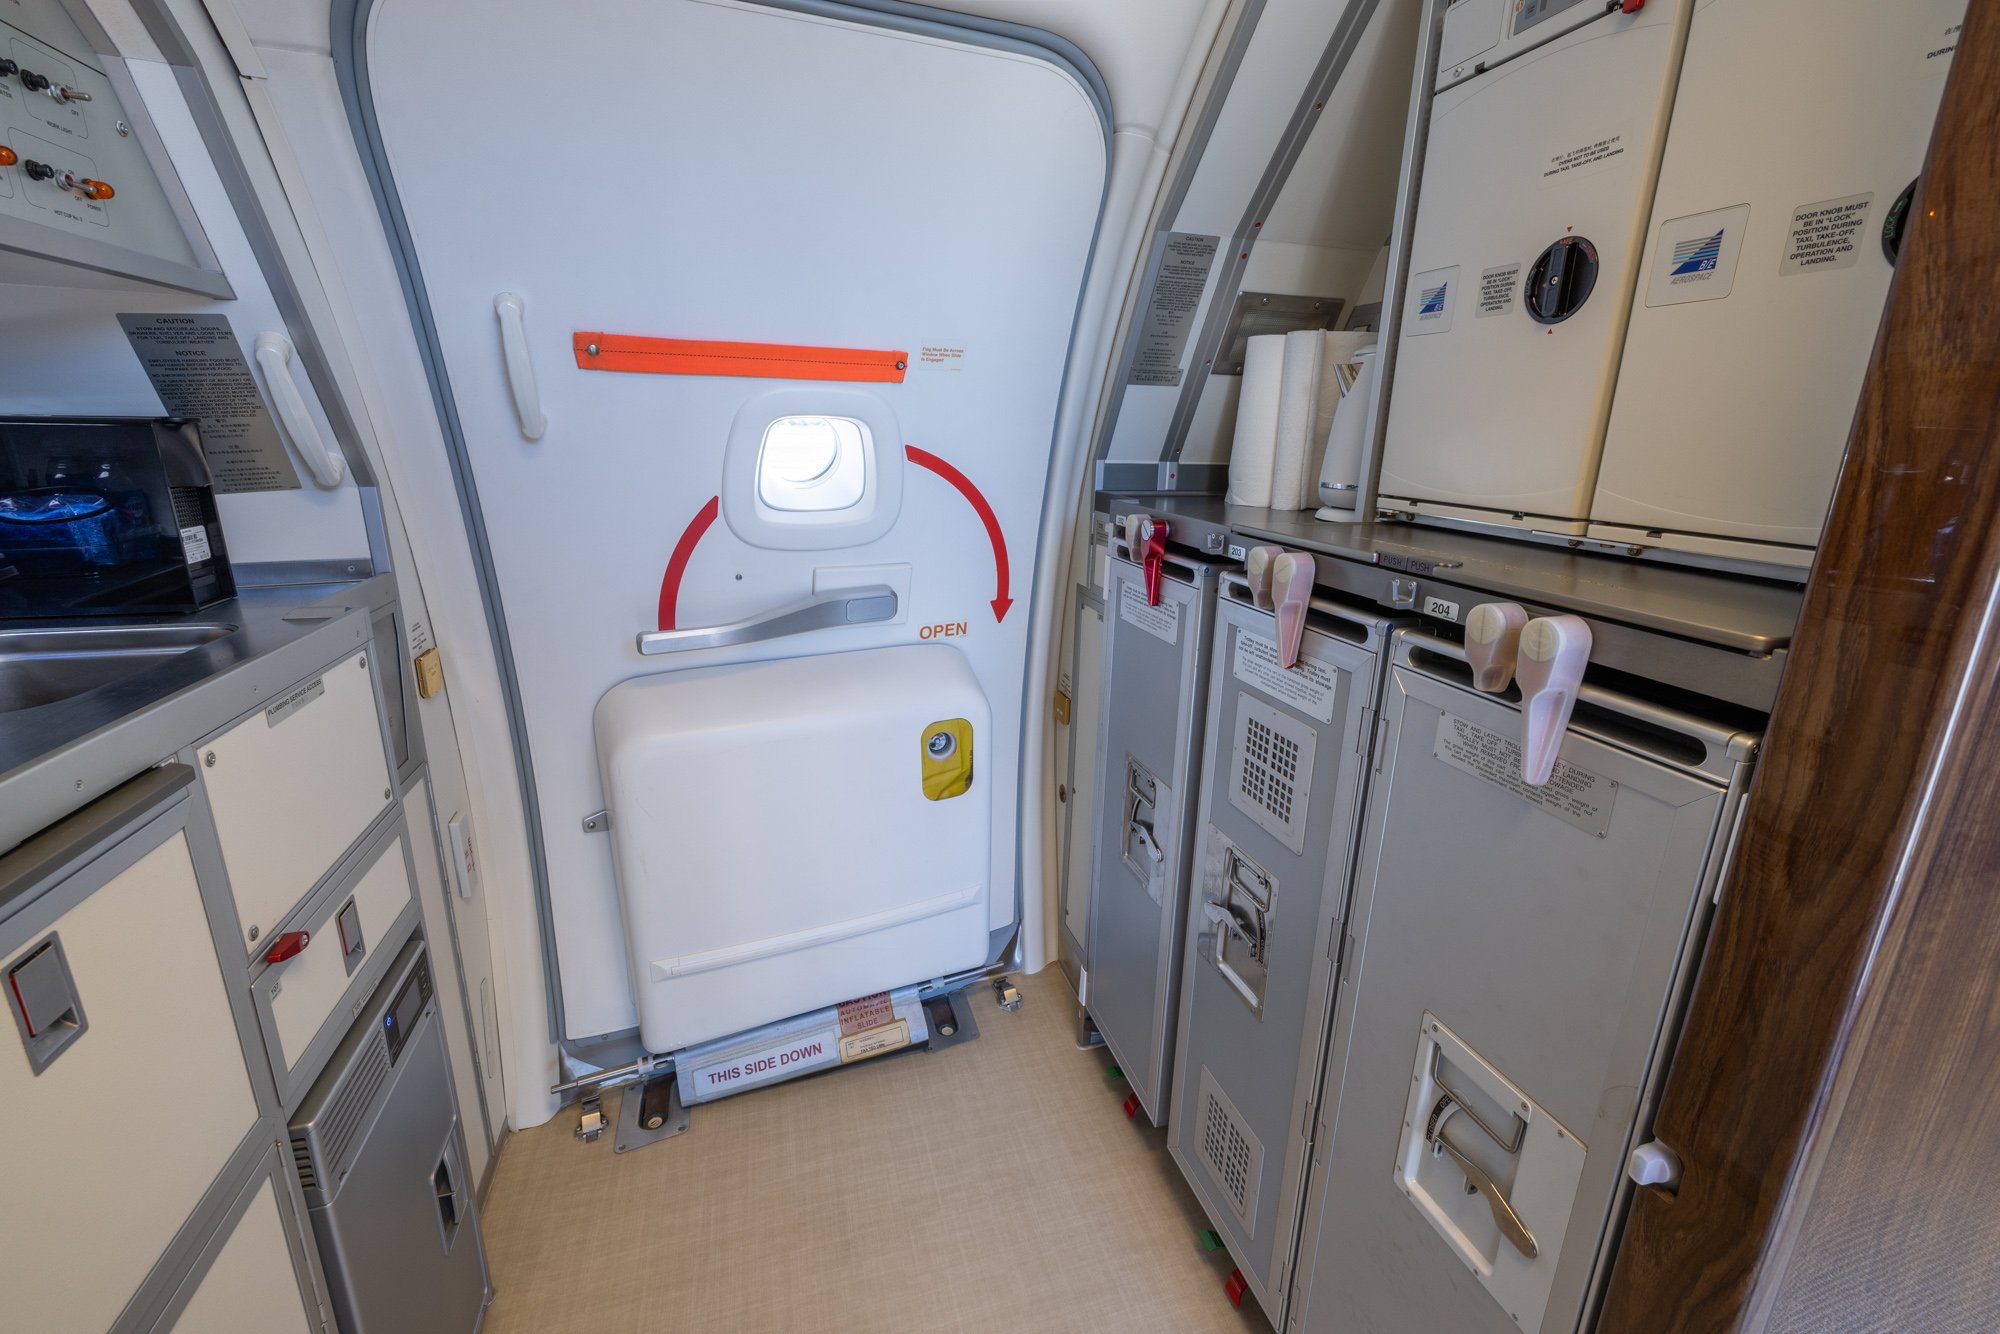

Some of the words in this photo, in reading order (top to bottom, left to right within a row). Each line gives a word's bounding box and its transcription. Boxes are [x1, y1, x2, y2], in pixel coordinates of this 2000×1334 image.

[1926, 46, 1954, 59] DURIN
[1795, 212, 1818, 221] DOOR
[1820, 207, 1843, 216] KNOB
[1844, 201, 1868, 211] MUST
[1792, 225, 1829, 237] POSITION
[1831, 219, 1863, 231] DURING
[1816, 228, 1855, 241] TAKE-OFF,
[1796, 238, 1850, 251] TURBULENCE,
[1790, 248, 1834, 260] OPERATION
[1800, 255, 1837, 266] LANDING.
[1231, 546, 1242, 557] 203
[1384, 555, 1402, 565] PUSH
[1411, 560, 1430, 572] PUSH
[1431, 602, 1450, 616] 204
[919, 622, 968, 640] OPEN
[267, 698, 290, 716] PLUMBING
[290, 688, 307, 703] SERVICE
[306, 679, 322, 692] ACCESS
[1454, 719, 1468, 729] STOW
[1470, 726, 1482, 734] AND
[1483, 732, 1502, 743] LATCH
[1504, 740, 1521, 752] TROLL
[1569, 767, 1596, 783] DURING
[1454, 725, 1464, 733] TAXI
[1471, 731, 1485, 741] TAKE
[1486, 739, 1497, 747] OFF
[1563, 772, 1592, 788] LANDING
[1463, 741, 1479, 751] WHEN
[1480, 749, 1507, 764] REMOVED
[1457, 732, 1480, 745] TROLLEY
[1481, 742, 1497, 753] MUST
[1499, 750, 1511, 759] NOT
[1550, 774, 1585, 792] ATTENDED
[1554, 790, 1569, 800] gross
[1572, 797, 1590, 808] weight
[1568, 803, 1581, 811] must
[840, 999, 888, 1016] AUTOIC
[840, 1005, 890, 1025] INFLATABLE
[857, 1018, 879, 1029] SLIDE
[708, 1067, 741, 1084] THIS
[744, 1057, 776, 1075] SIDE
[780, 1042, 822, 1066] DOWN
